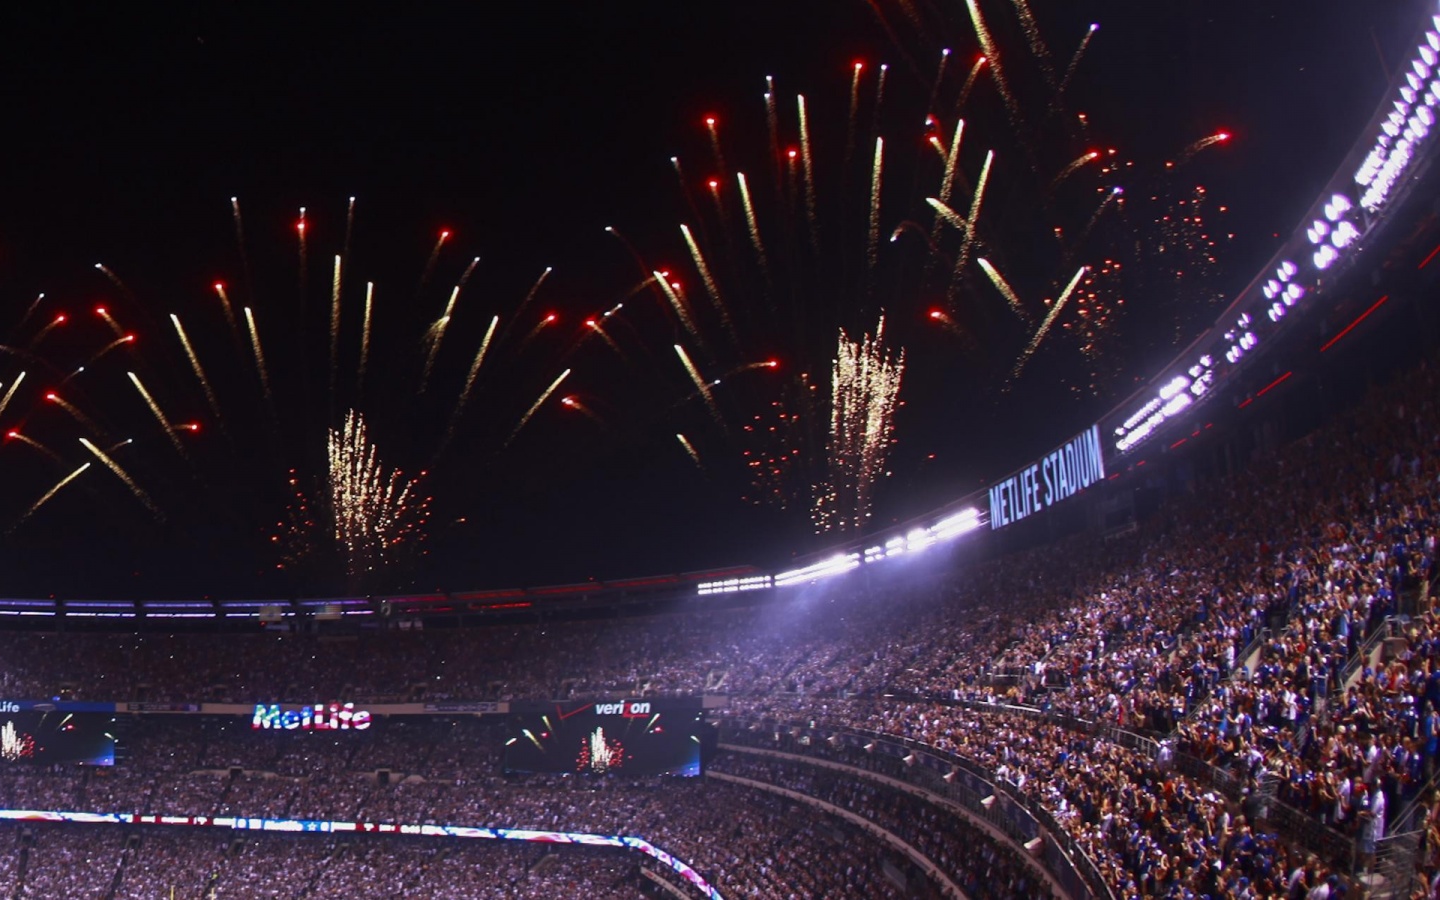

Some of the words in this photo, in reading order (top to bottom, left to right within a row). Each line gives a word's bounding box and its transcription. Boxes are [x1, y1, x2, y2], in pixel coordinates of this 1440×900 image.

[989, 463, 1042, 530] METLIFE
[1042, 424, 1105, 506] STADIUM
[252, 702, 373, 731] MetLife
[595, 699, 651, 718] verizon
